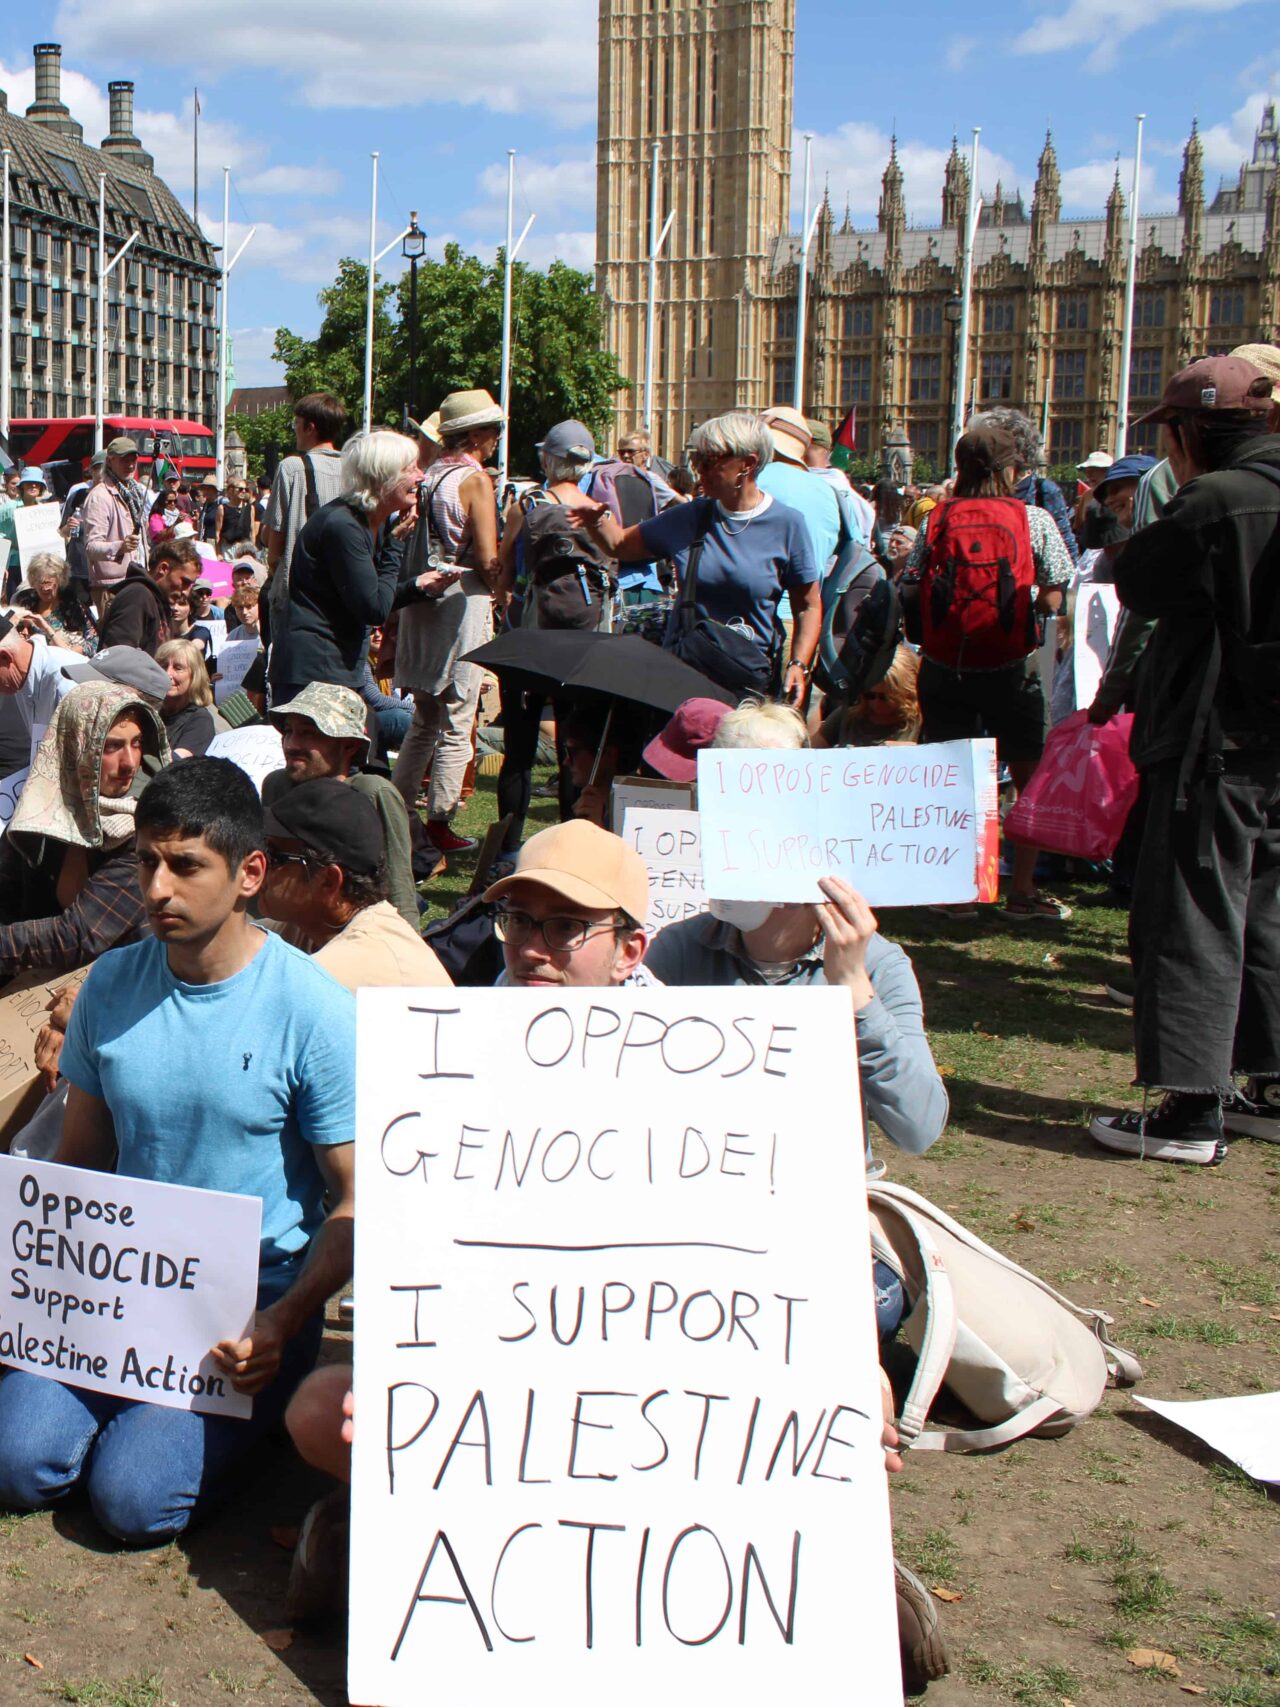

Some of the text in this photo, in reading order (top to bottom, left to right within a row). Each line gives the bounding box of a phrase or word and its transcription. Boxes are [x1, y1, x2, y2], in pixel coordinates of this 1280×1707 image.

[716, 761, 726, 794] I
[739, 761, 833, 793] OPPOSE
[842, 762, 960, 788] GENOCIDE
[870, 803, 974, 833] PALESTINE
[718, 829, 739, 872] I
[748, 829, 863, 871] SUPPORT
[866, 841, 960, 868] ACTION
[407, 1004, 798, 1080] I OPPOSE
[380, 1111, 778, 1196] GENOCIDE!
[20, 1175, 135, 1229] Oppose
[12, 1220, 200, 1290] GENOCIDE
[10, 1268, 124, 1324] Support
[389, 1281, 808, 1365] I SUPPORT
[120, 1348, 225, 1399] Action
[385, 1381, 871, 1495] PALESTINE
[390, 1519, 802, 1661] ACTION
